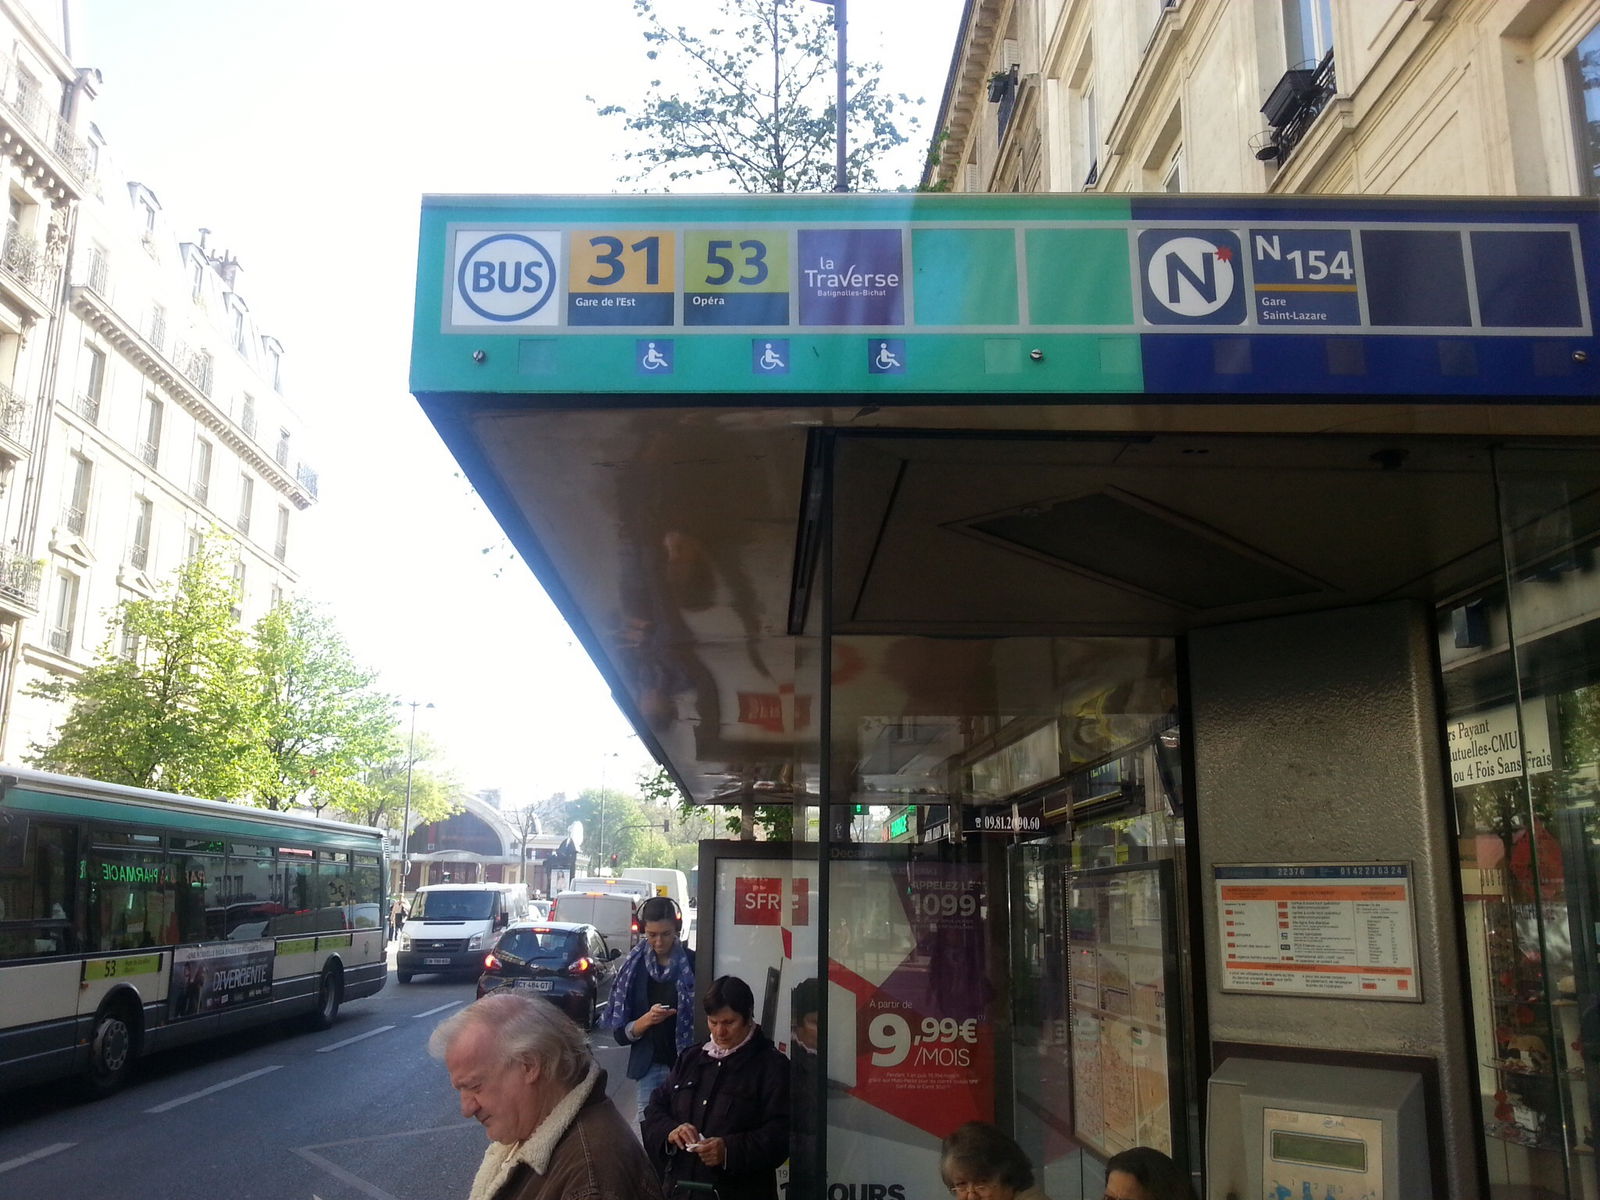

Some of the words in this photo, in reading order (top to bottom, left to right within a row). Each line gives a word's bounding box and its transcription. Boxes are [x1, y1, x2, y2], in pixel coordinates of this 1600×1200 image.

[587, 236, 659, 286] 31
[705, 240, 769, 286] 53
[820, 256, 834, 270] la
[1286, 250, 1353, 280] 154
[472, 261, 543, 293] BUS
[804, 264, 899, 287] Traverse
[1165, 252, 1217, 304] N
[575, 297, 599, 307] Gare
[601, 297, 614, 307] de
[616, 297, 636, 307] l'Est
[692, 296, 725, 307] Opéra
[817, 289, 886, 298] Batignolles-Bichat
[1262, 297, 1287, 307] Gare
[1263, 311, 1327, 321] Saint-Lazare
[1458, 720, 1490, 741] Payant
[1450, 730, 1518, 762] utuelles-CMU
[1453, 771, 1465, 783] ou
[1467, 763, 1473, 780] 4
[1475, 760, 1495, 779] Fois
[1497, 756, 1522, 775] Sans
[911, 880, 959, 891] APPELEZ
[961, 881, 975, 891] LE
[745, 892, 780, 910] SFR
[910, 893, 976, 917] 1099
[104, 960, 116, 978] 53
[213, 965, 268, 992] DIVERGENTE
[878, 1001, 900, 1010] partir
[902, 1000, 913, 1009] de
[913, 1047, 970, 1067] /MOIS
